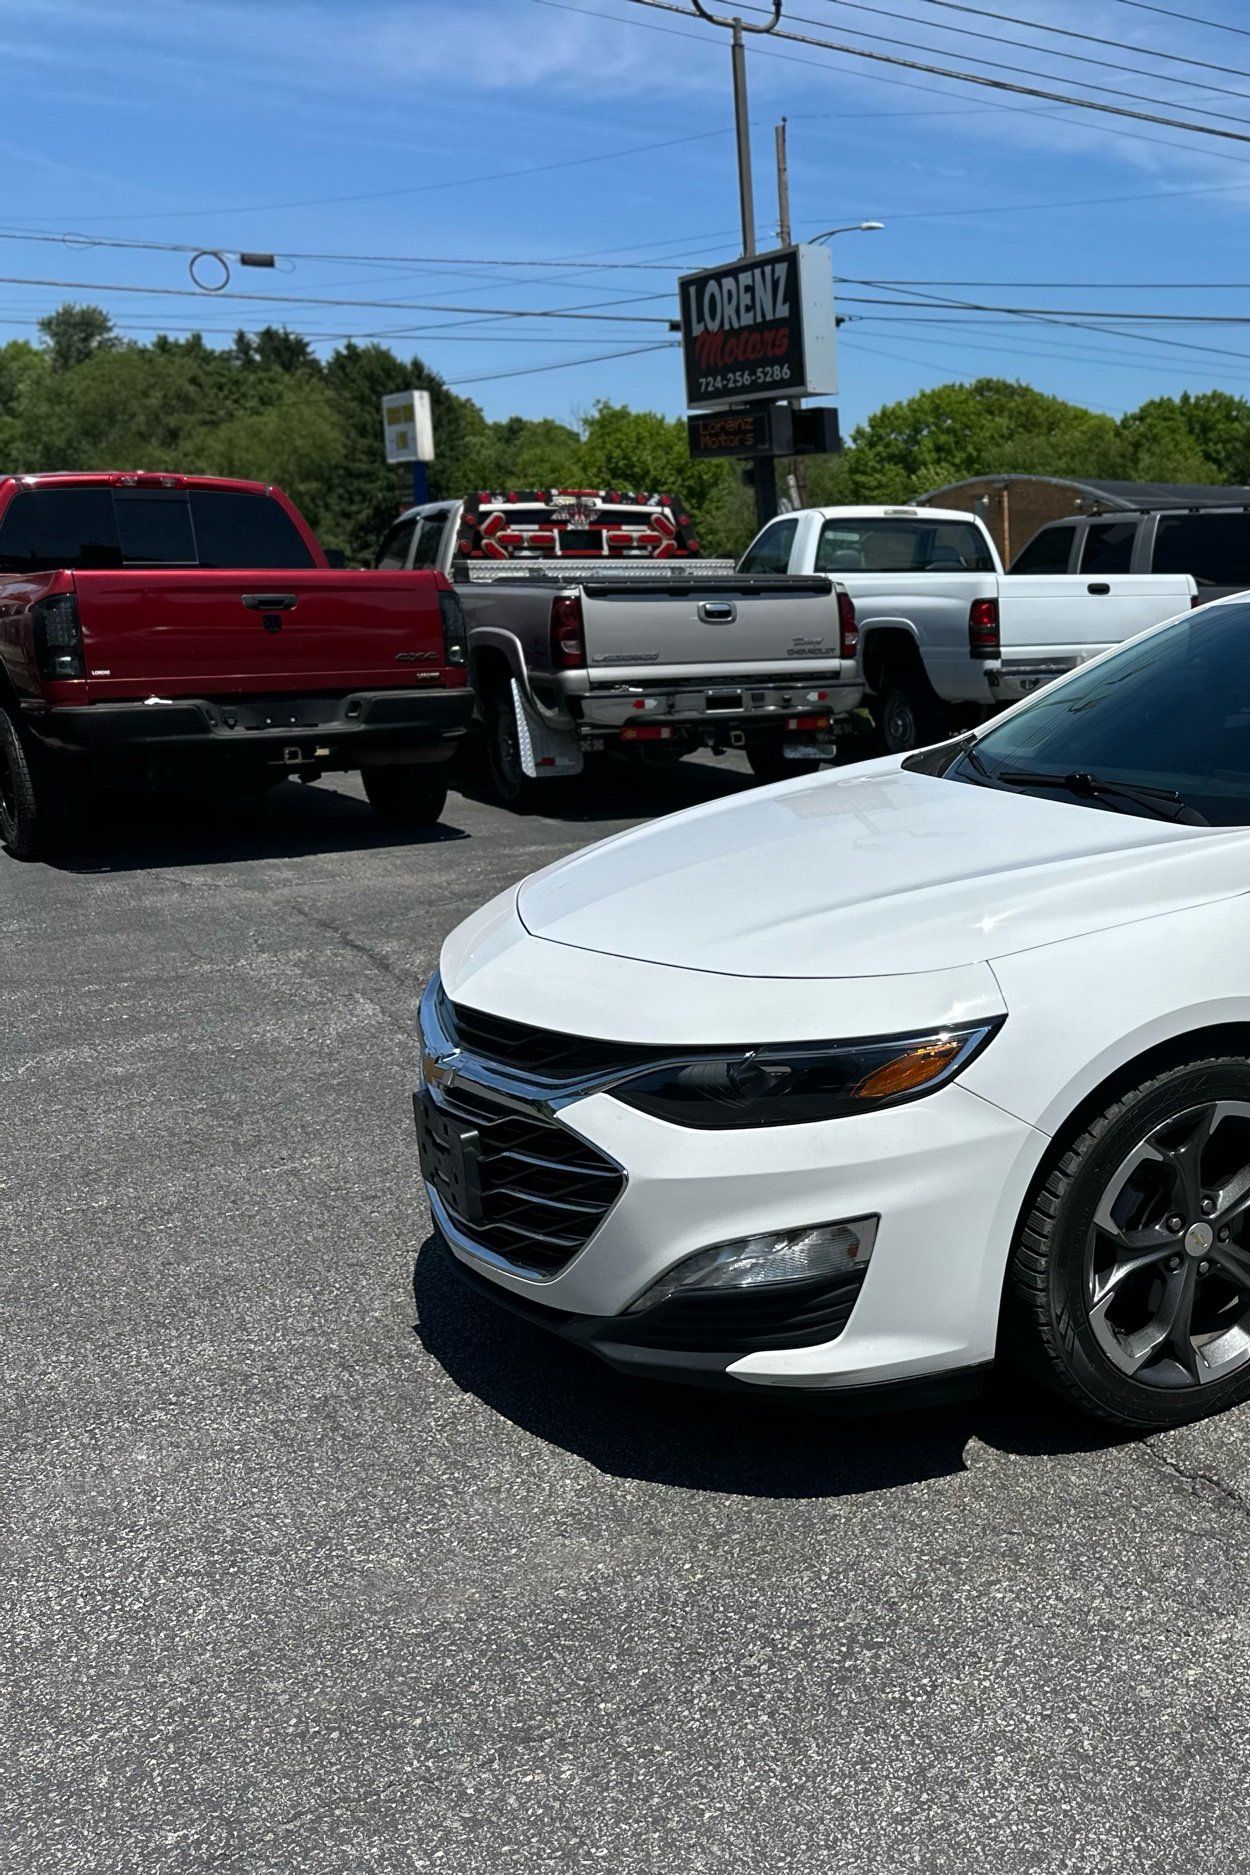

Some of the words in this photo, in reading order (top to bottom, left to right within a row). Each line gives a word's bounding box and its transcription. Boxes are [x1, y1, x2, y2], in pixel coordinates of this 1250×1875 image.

[689, 262, 790, 337] LORENZ
[695, 327, 789, 369] Motors
[699, 364, 791, 392] 724-256-5286
